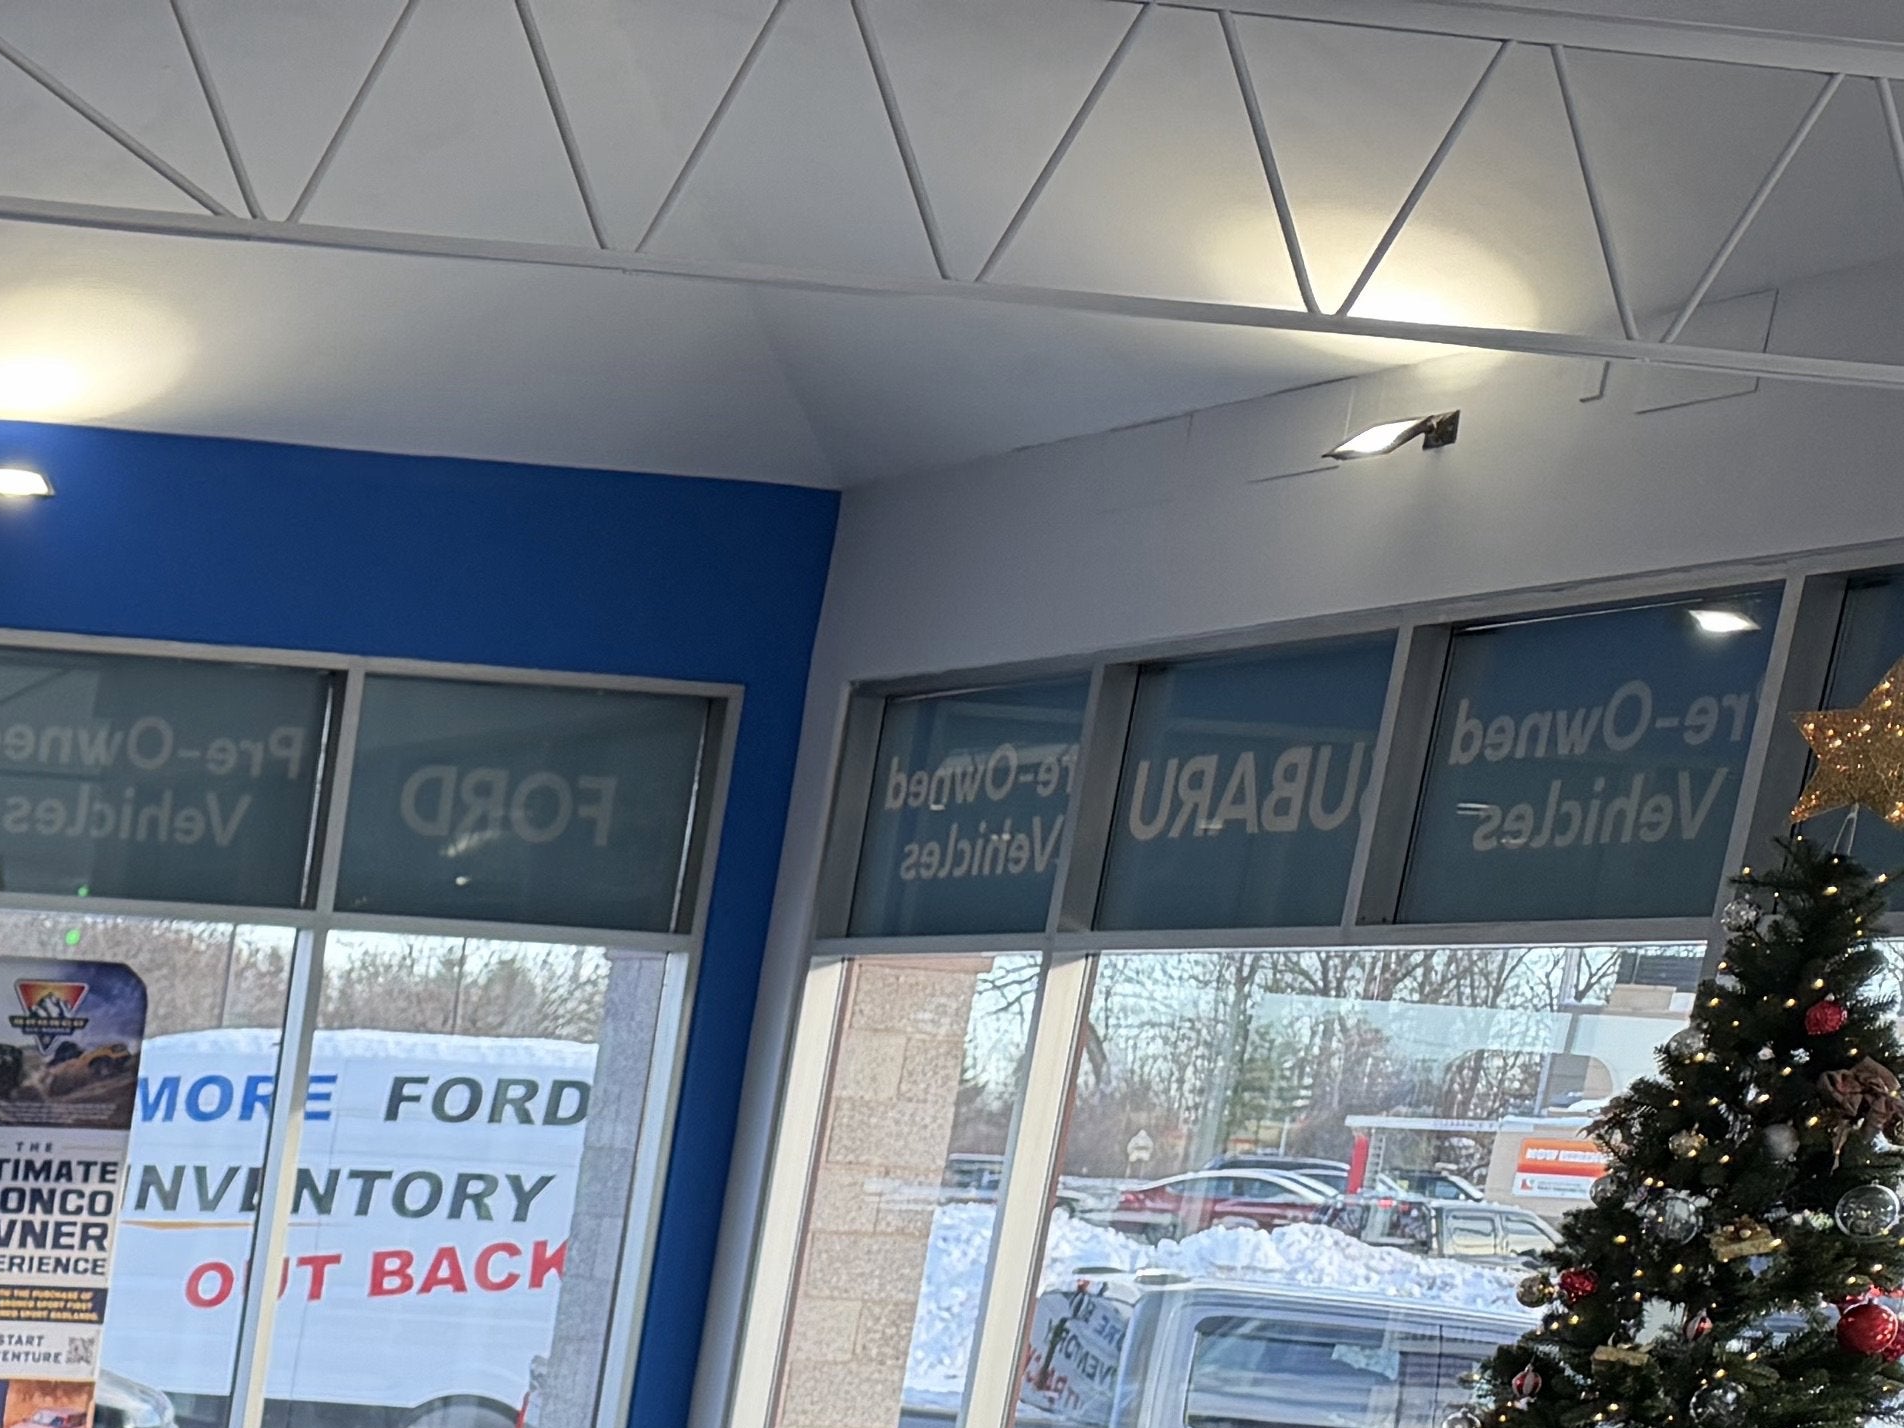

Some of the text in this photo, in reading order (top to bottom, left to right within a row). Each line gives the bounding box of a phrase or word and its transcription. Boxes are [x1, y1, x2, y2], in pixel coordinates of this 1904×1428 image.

[137, 1073, 338, 1123] MORE
[383, 1075, 593, 1126] FORD
[15, 1141, 54, 1153] THE
[367, 1239, 569, 1298] BACK
